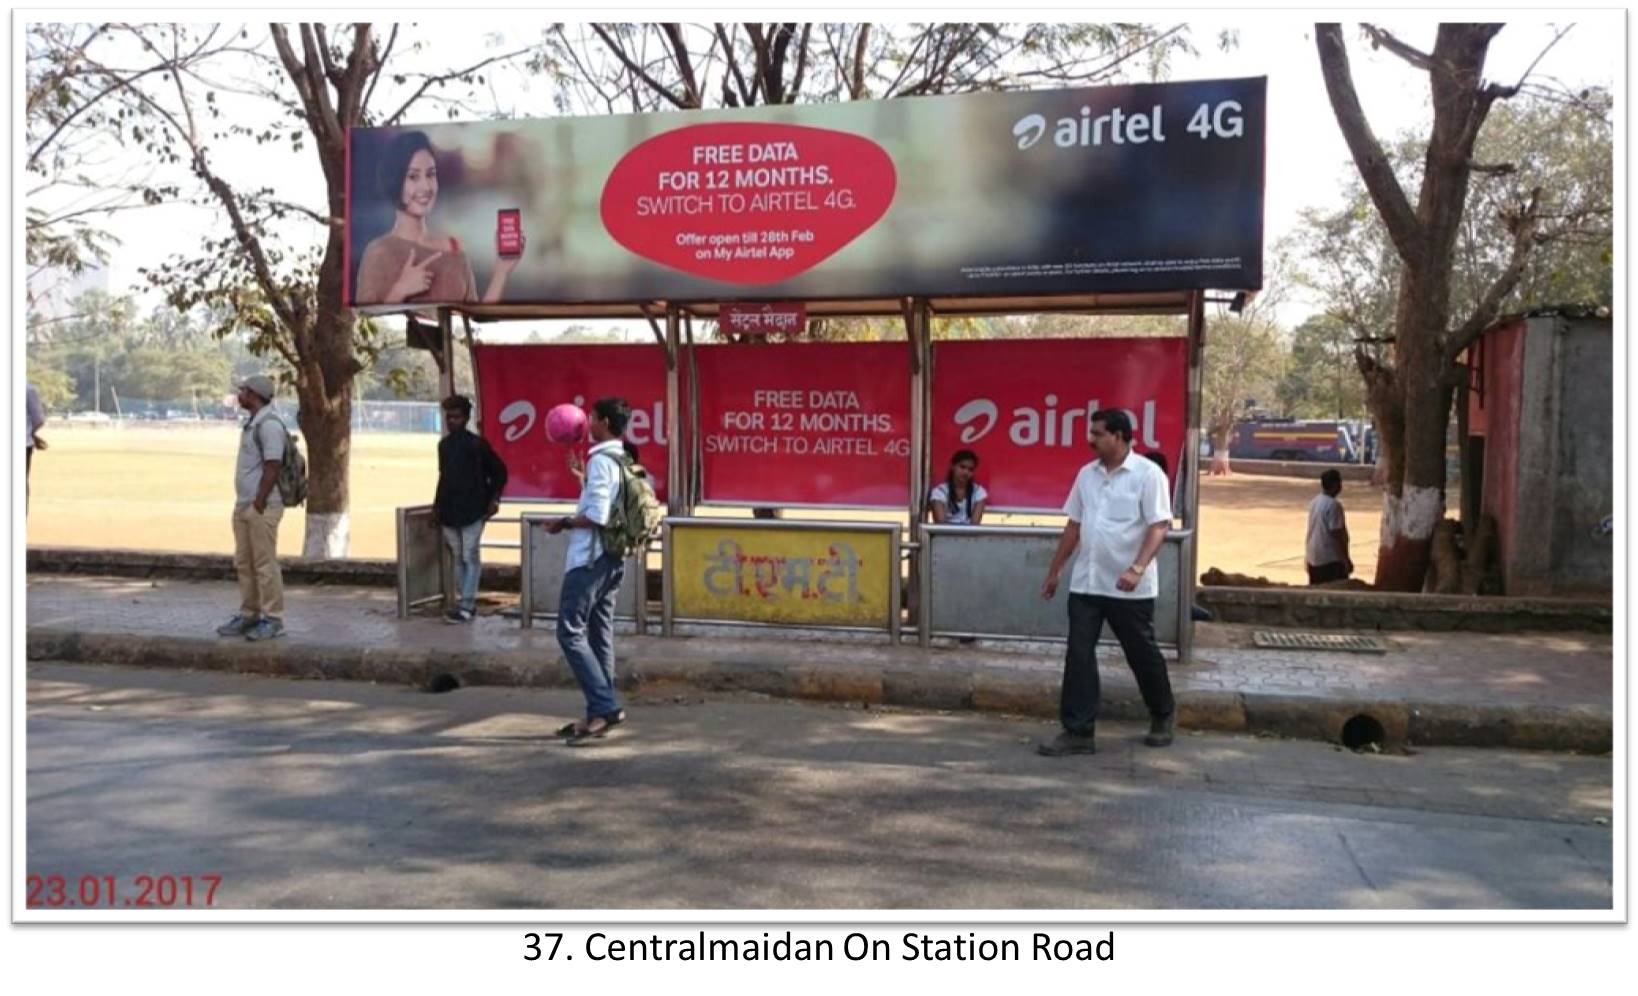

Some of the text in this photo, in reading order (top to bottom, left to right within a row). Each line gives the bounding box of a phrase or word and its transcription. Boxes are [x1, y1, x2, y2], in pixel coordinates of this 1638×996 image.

[1054, 100, 1244, 147] airtel 4G
[692, 141, 799, 165] FREE DATA
[658, 165, 834, 191] FOR 12 MONTHS.
[636, 188, 856, 216] SWITCH TO AIRTEL 4G.
[676, 229, 815, 247] Offer open till 28th Feb
[695, 245, 795, 261] on My Airtel App
[754, 389, 860, 409] FREE DATA
[724, 412, 765, 430] FOR
[771, 413, 794, 431] 12
[1009, 394, 1160, 447] airl
[705, 435, 778, 453] SWITCH
[783, 437, 809, 454] TO
[813, 438, 879, 456] AIRTEL
